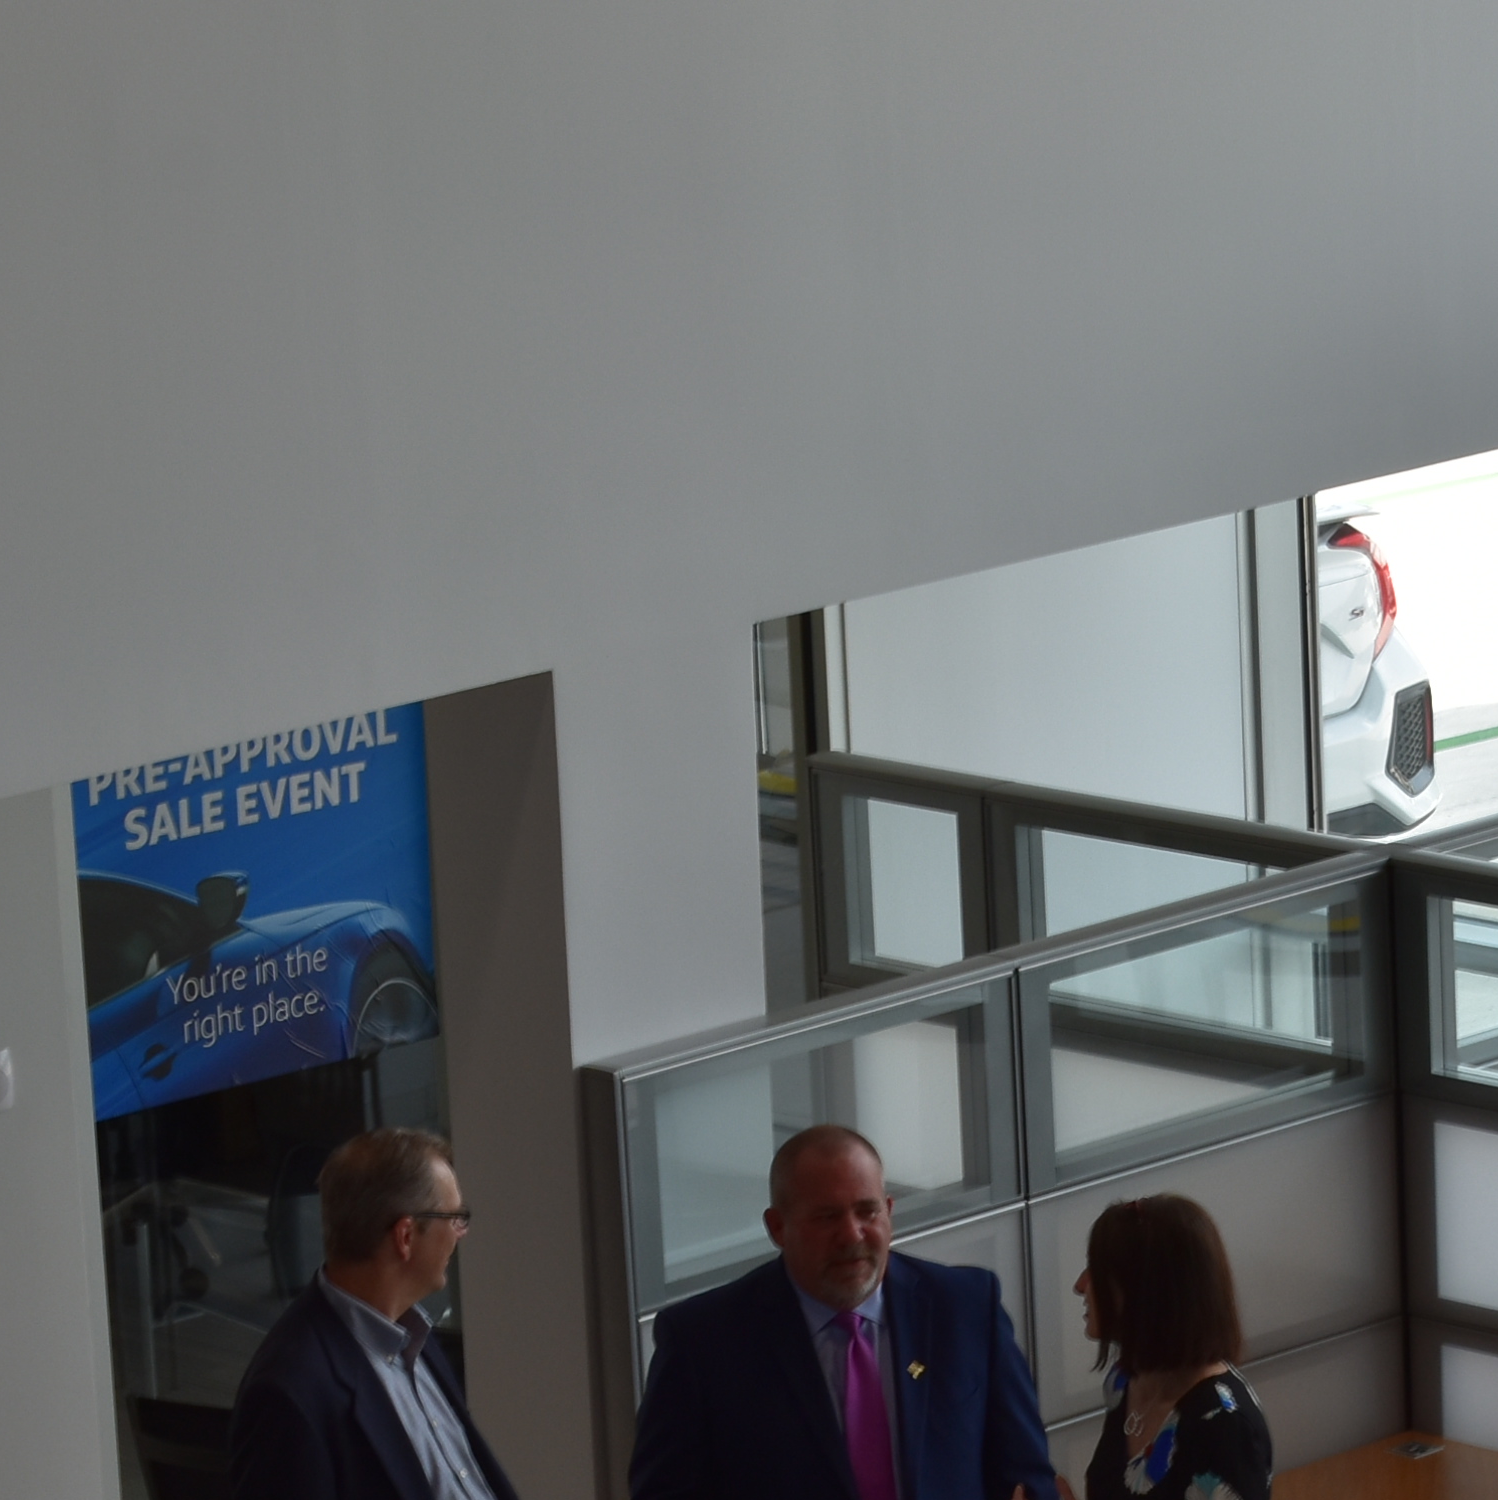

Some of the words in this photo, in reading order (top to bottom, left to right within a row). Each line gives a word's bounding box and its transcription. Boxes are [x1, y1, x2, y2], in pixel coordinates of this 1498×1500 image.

[87, 708, 399, 806] PRE-APPROVAL
[123, 790, 226, 852] SALE
[236, 761, 367, 826] EVENT
[255, 954, 278, 986] in
[284, 944, 329, 979] the
[183, 1004, 245, 1048] right
[252, 991, 326, 1036] place.
